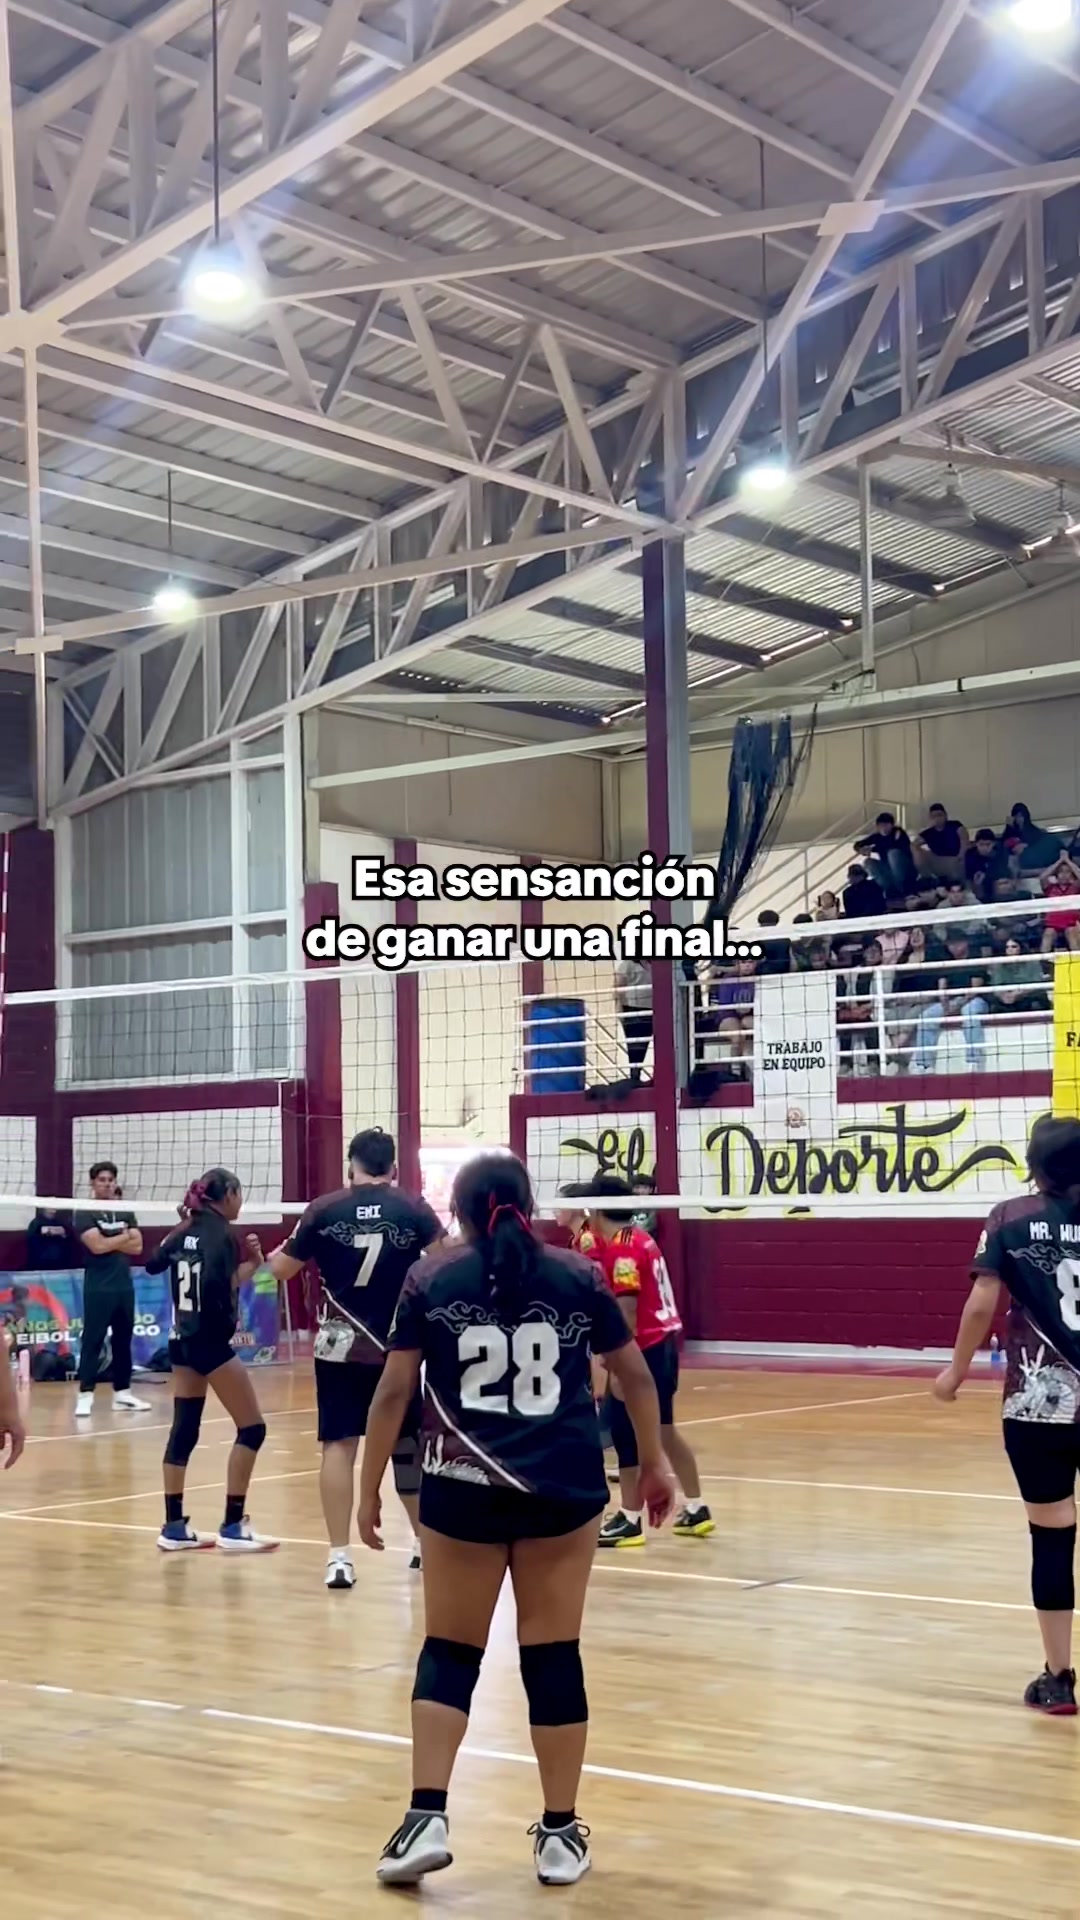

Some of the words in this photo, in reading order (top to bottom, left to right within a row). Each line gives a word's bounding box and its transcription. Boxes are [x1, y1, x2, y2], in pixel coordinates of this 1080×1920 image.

[763, 1058, 780, 1071] EN
[782, 1057, 826, 1072] EQUIPO
[766, 1041, 823, 1055] TRABAJO
[703, 1104, 1017, 1213] Deporte
[1029, 1221, 1053, 1240] MR.
[1060, 1223, 1080, 1243] WU
[177, 1260, 201, 1313] 21
[354, 1233, 383, 1288] 7
[457, 1322, 562, 1416] 28
